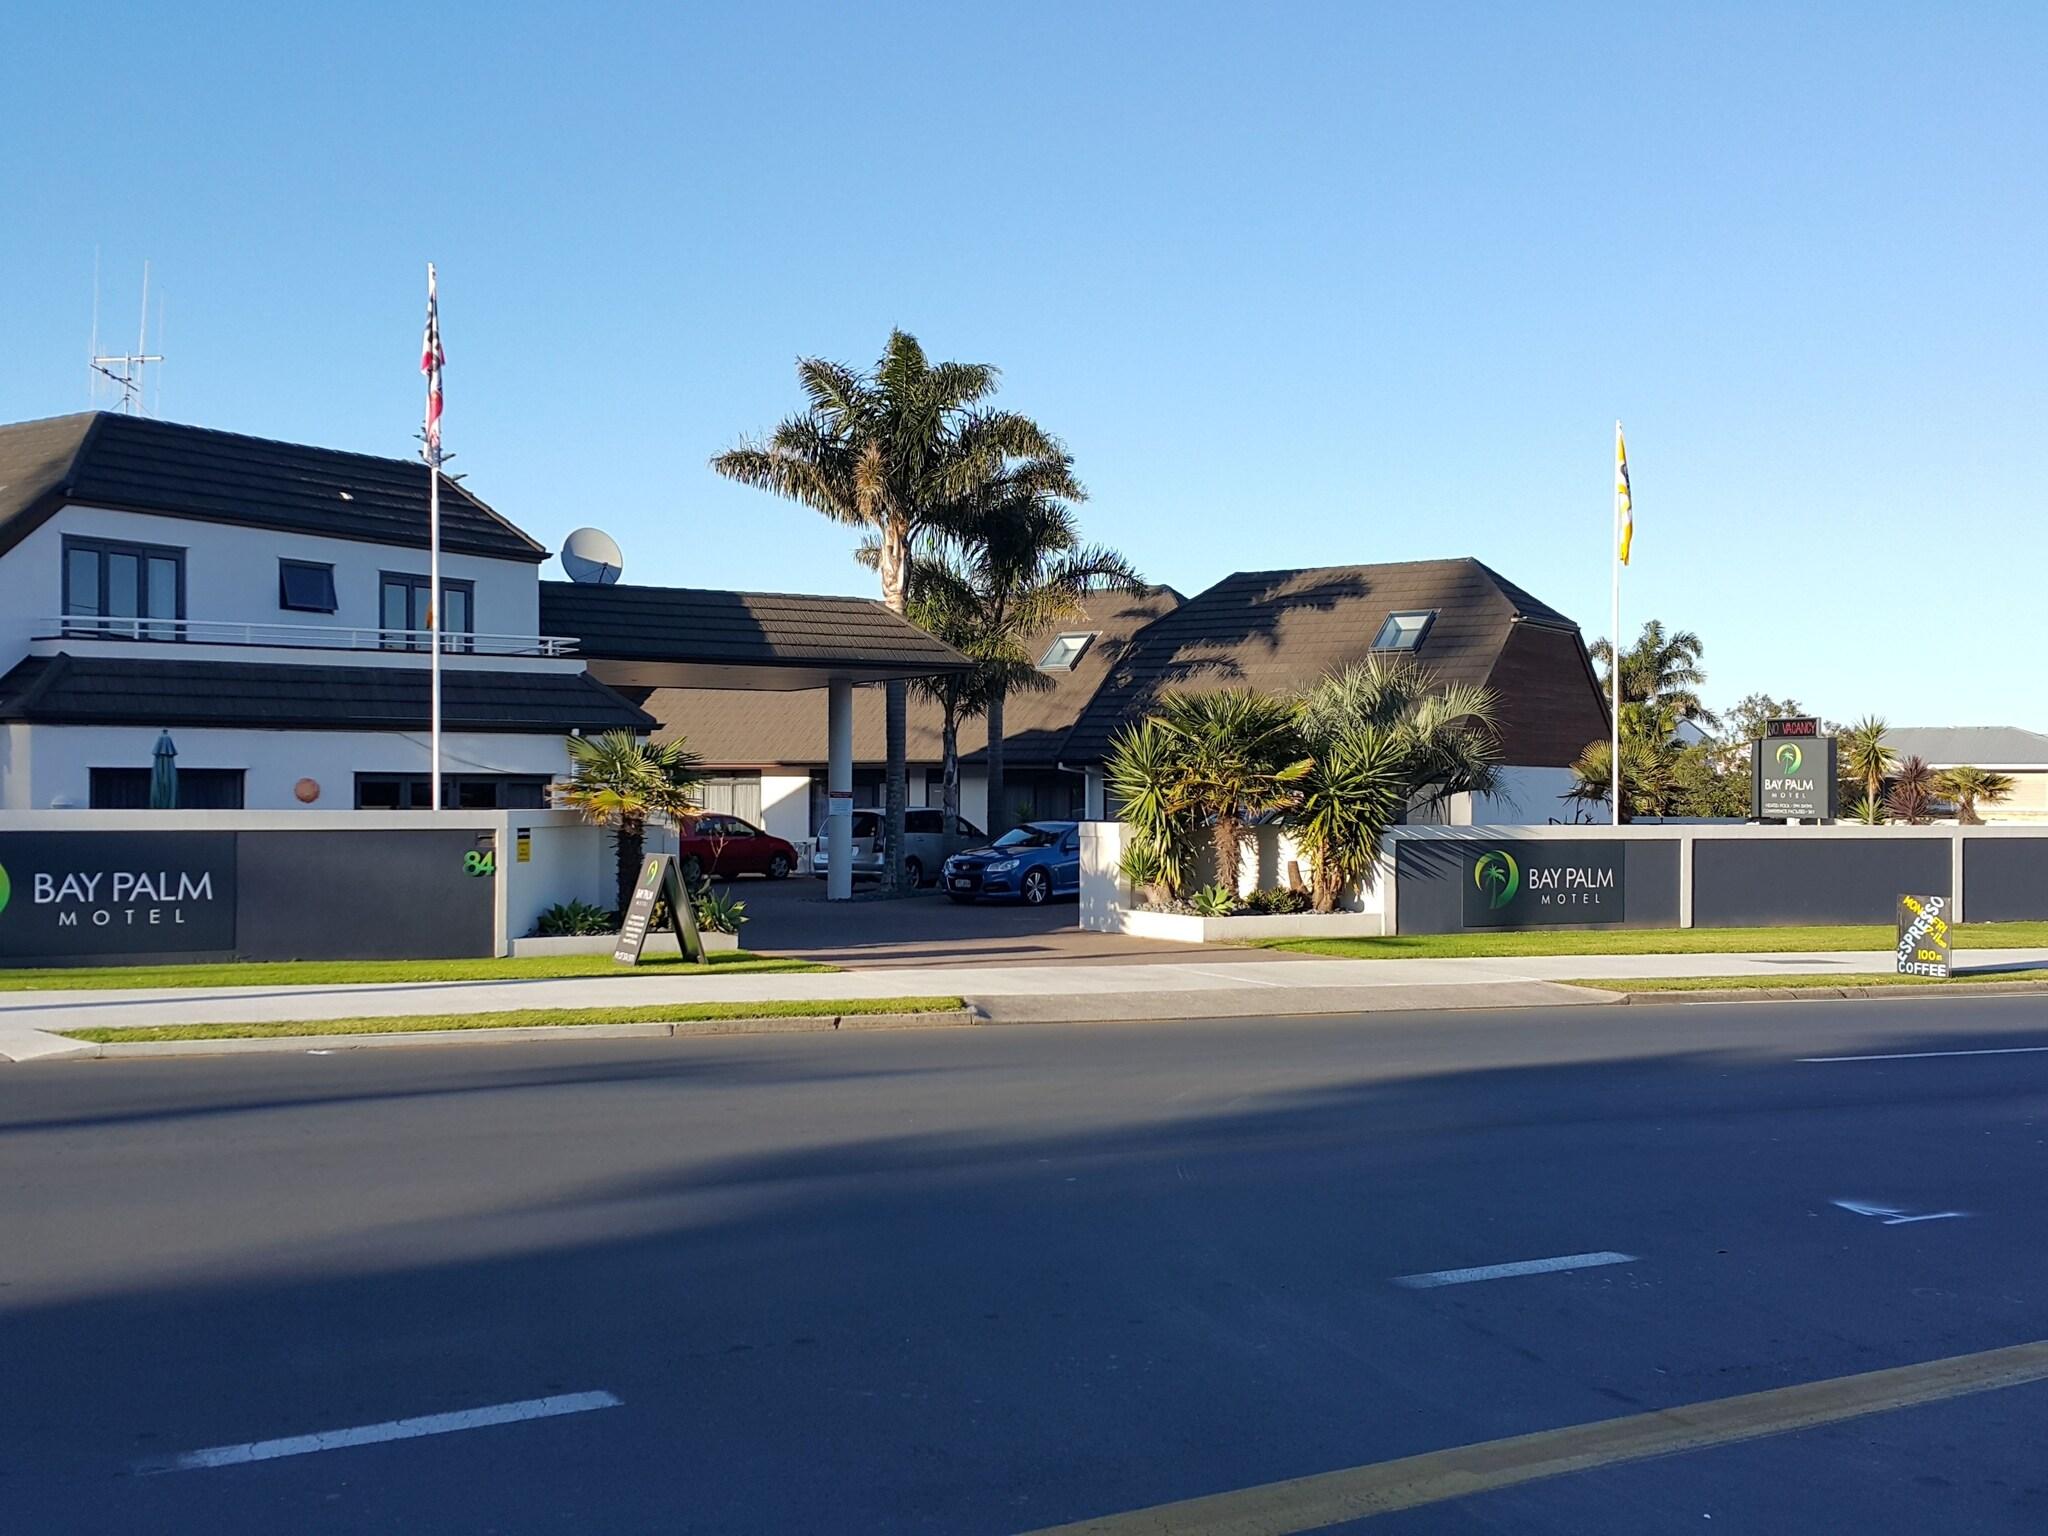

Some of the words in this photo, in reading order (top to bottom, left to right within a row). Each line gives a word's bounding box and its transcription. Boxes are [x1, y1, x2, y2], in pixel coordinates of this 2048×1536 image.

[1767, 722, 1780, 736] NO
[1782, 721, 1817, 735] VACANCY
[1764, 779, 1783, 791] BAY
[1785, 779, 1814, 791] PALM
[463, 850, 495, 876] 84
[34, 871, 103, 904] BAY
[112, 871, 213, 902] PALM
[1529, 867, 1562, 889] BAY
[1566, 867, 1614, 889] PALM
[1541, 893, 1601, 905] MOTEL
[58, 908, 185, 926] MOTEL
[1903, 895, 1924, 915] MON
[1931, 916, 1949, 933] FRI
[1898, 896, 1945, 962] ESPRESSO
[1898, 961, 1947, 977] COFFEE
